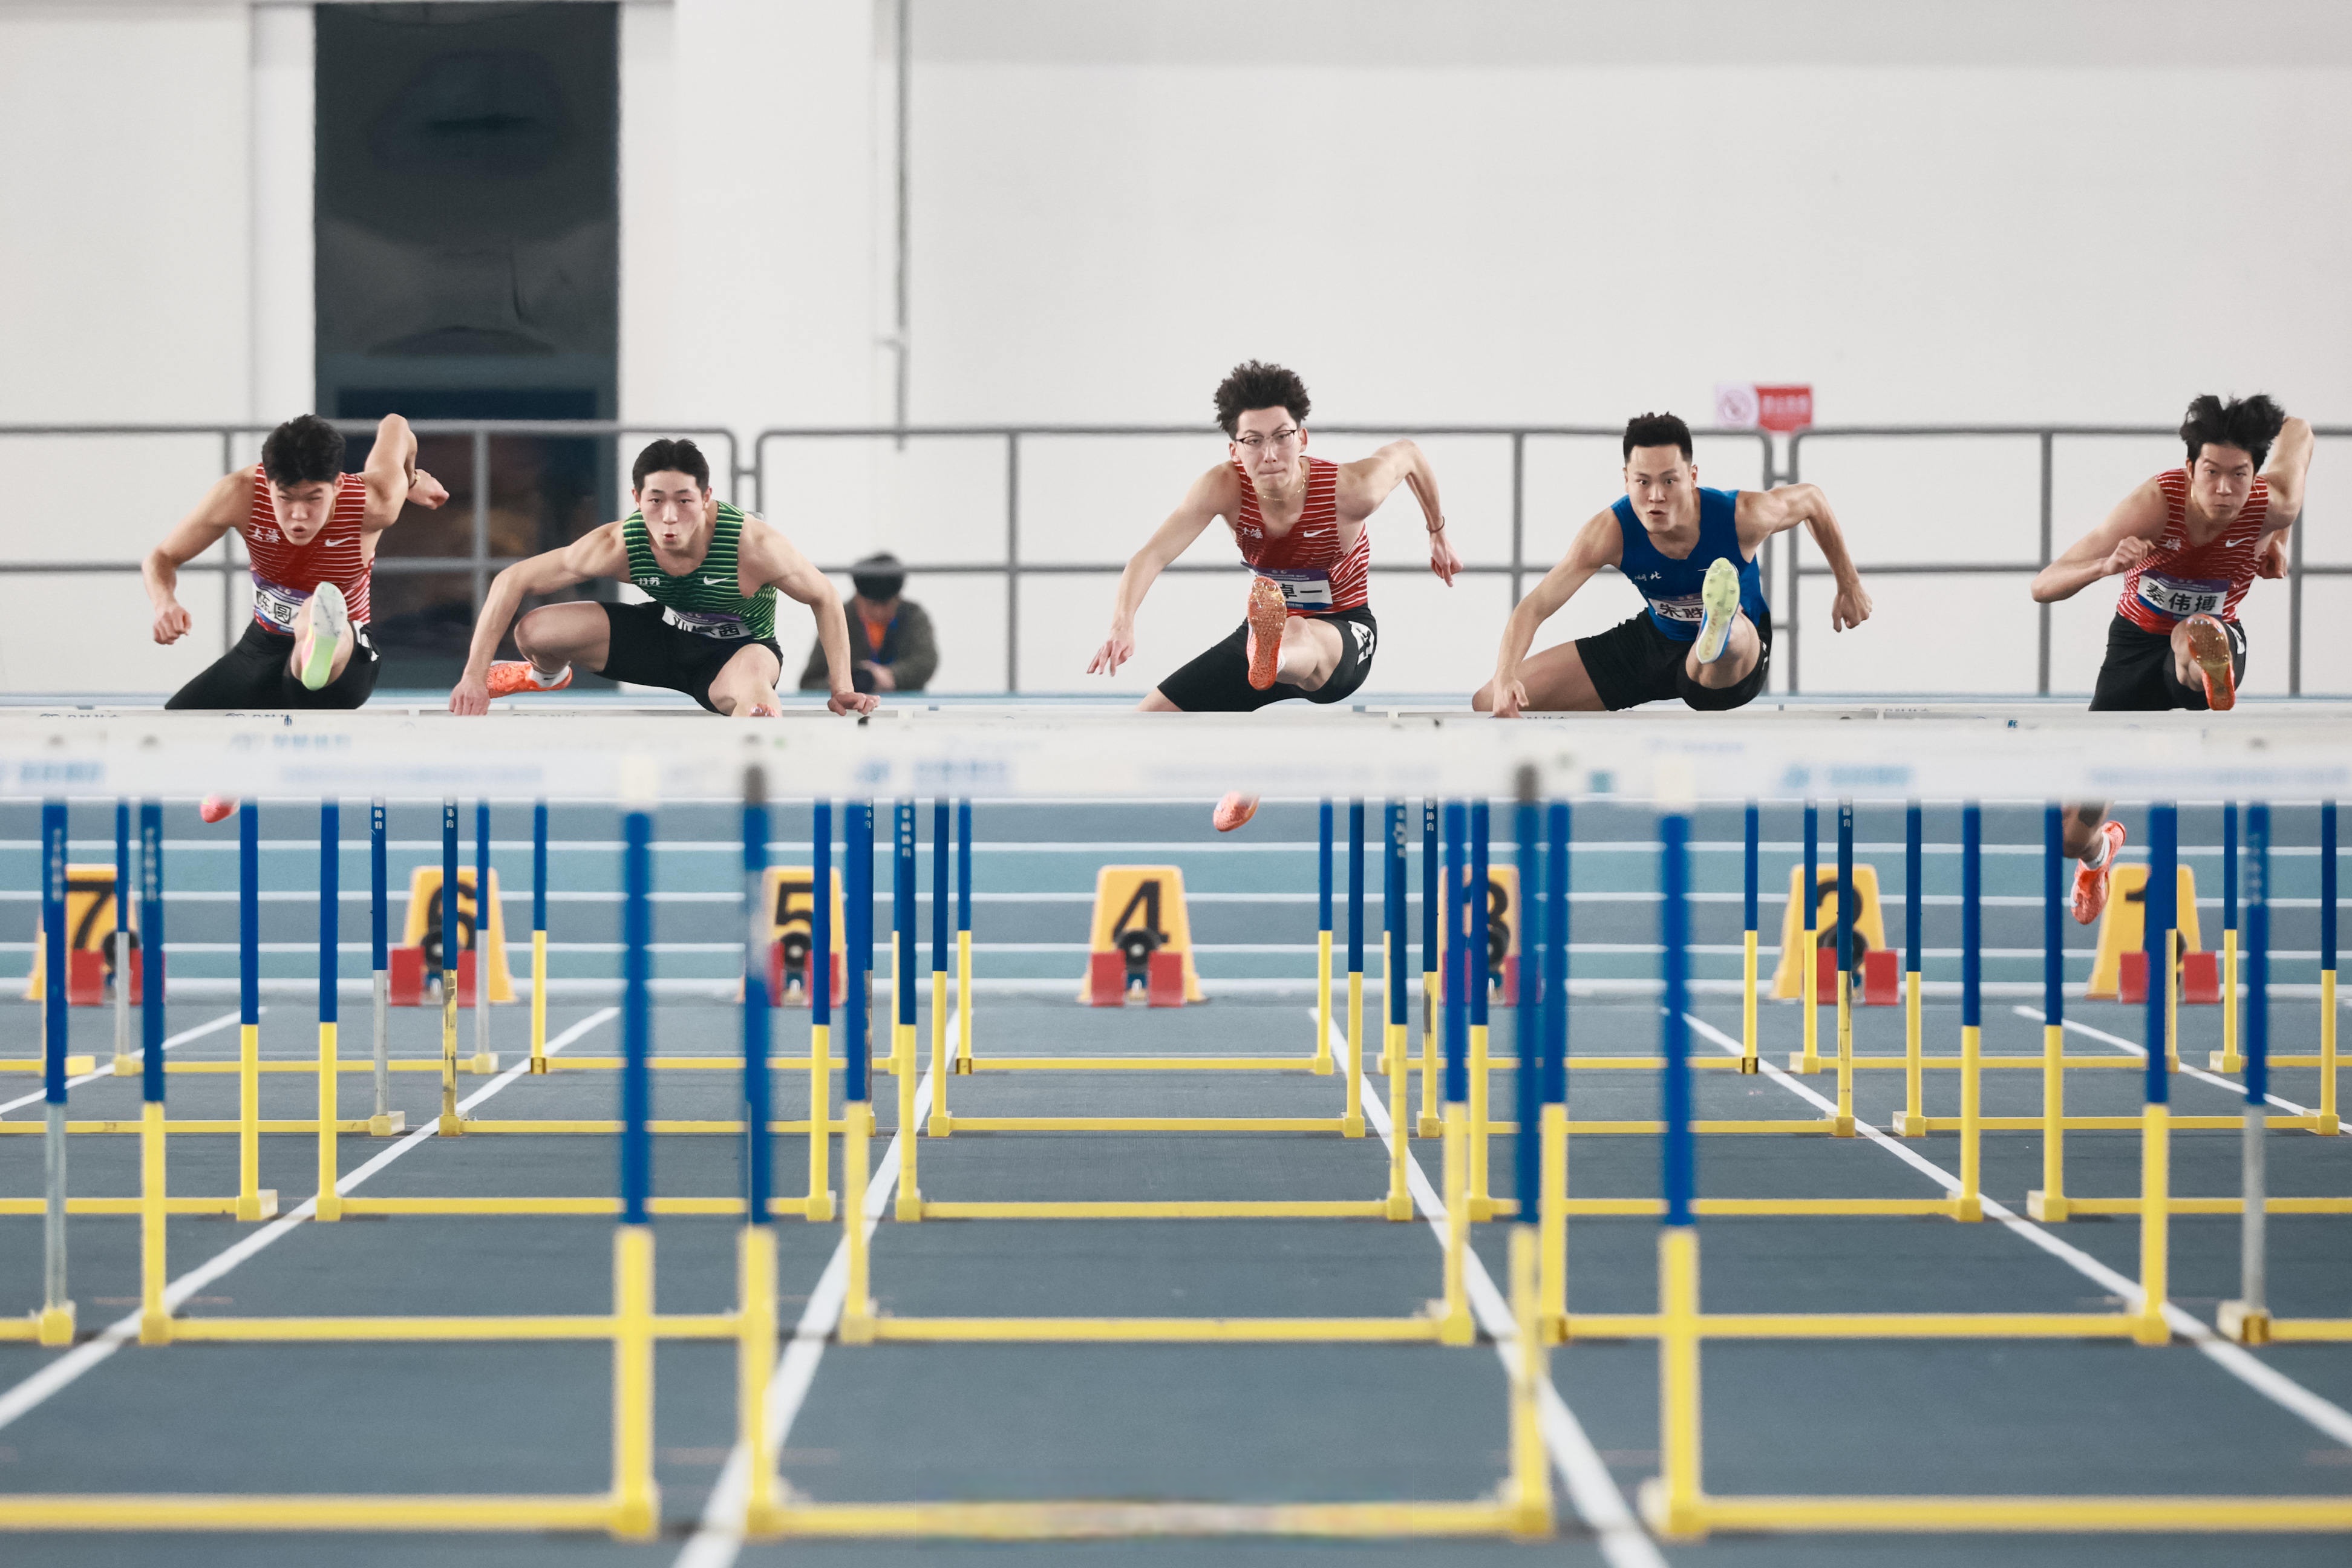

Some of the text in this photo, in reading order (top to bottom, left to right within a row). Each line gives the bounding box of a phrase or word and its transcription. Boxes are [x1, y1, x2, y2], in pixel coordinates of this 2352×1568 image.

[253, 528, 281, 544] 上海
[256, 590, 299, 625] 陈圆
[68, 881, 115, 950] 7
[428, 882, 477, 950] 6
[775, 882, 813, 941] 5
[1112, 881, 1169, 944] 4
[1816, 880, 1863, 948] 2
